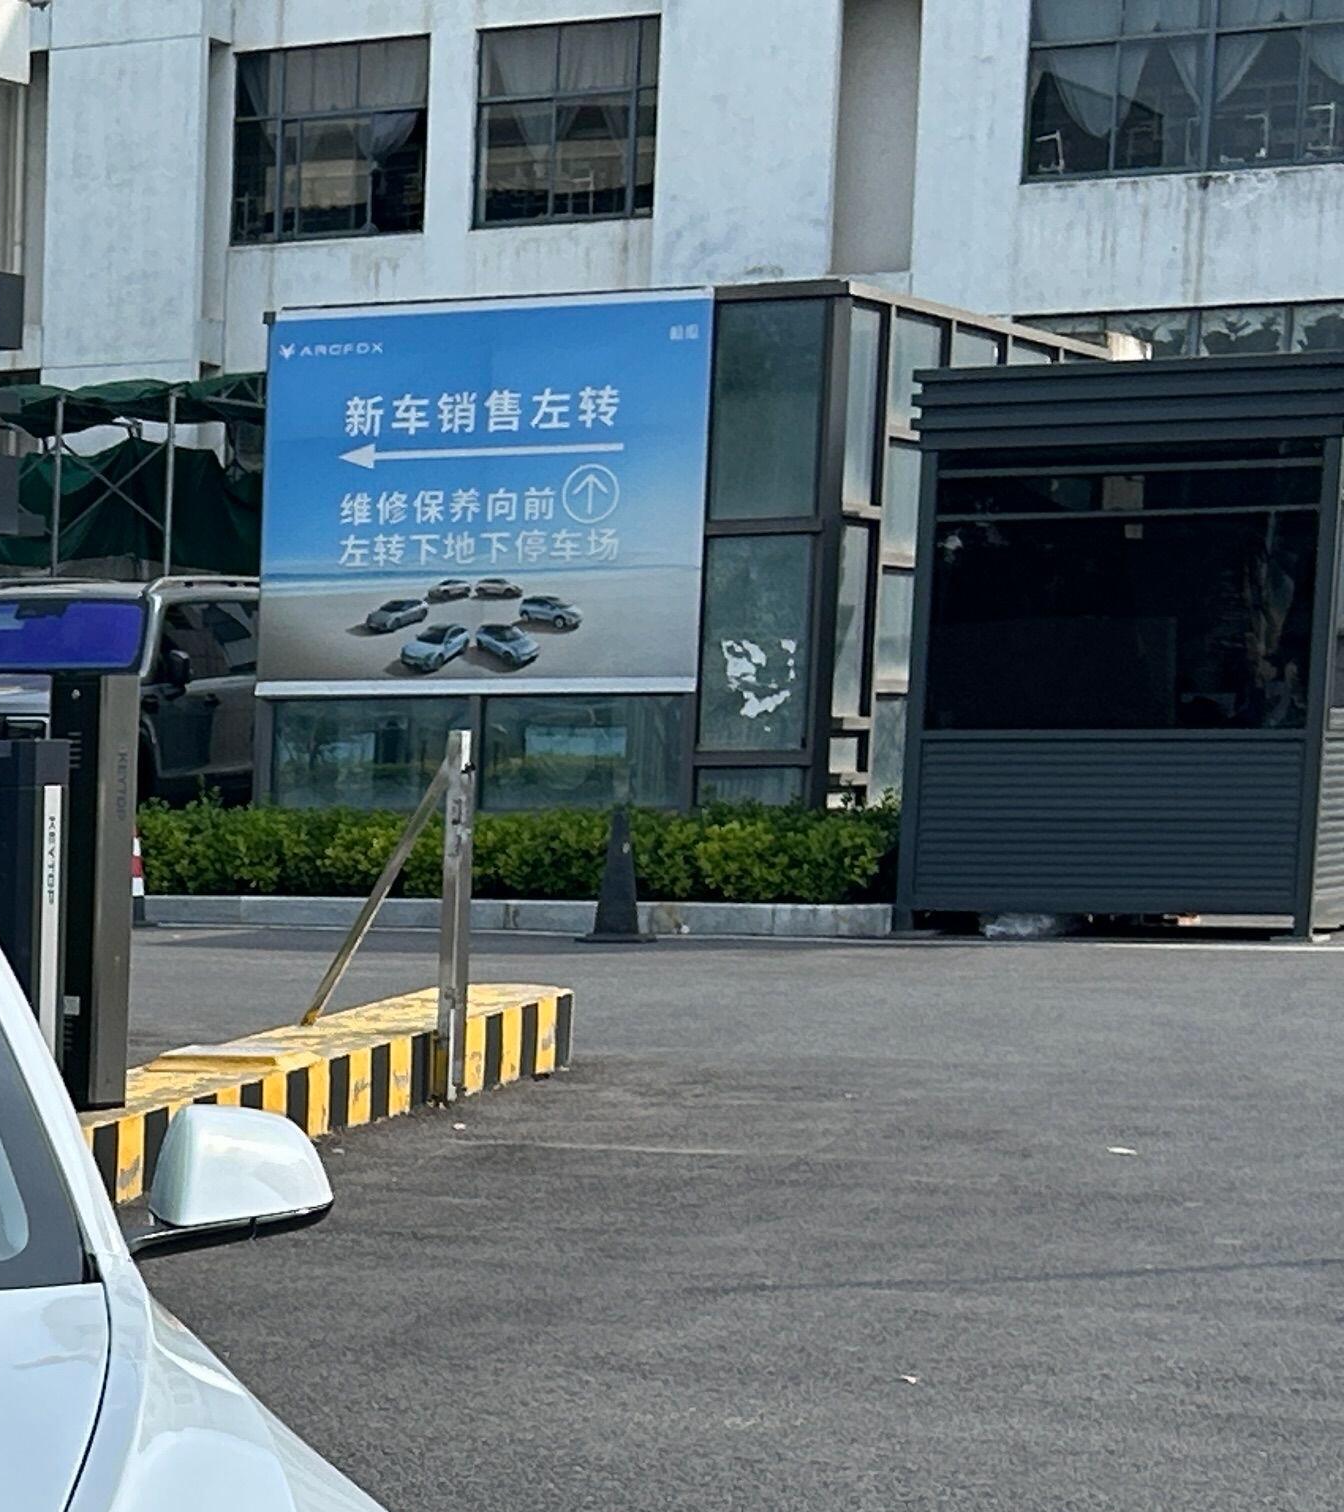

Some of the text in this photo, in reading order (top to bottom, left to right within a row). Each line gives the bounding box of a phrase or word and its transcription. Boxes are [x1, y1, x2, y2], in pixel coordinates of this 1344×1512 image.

[300, 342, 384, 357] ARCFOX
[345, 385, 621, 438] 新车销售左转
[339, 486, 557, 527] 维修保养向前
[338, 528, 619, 568] 左转下地下停车场
